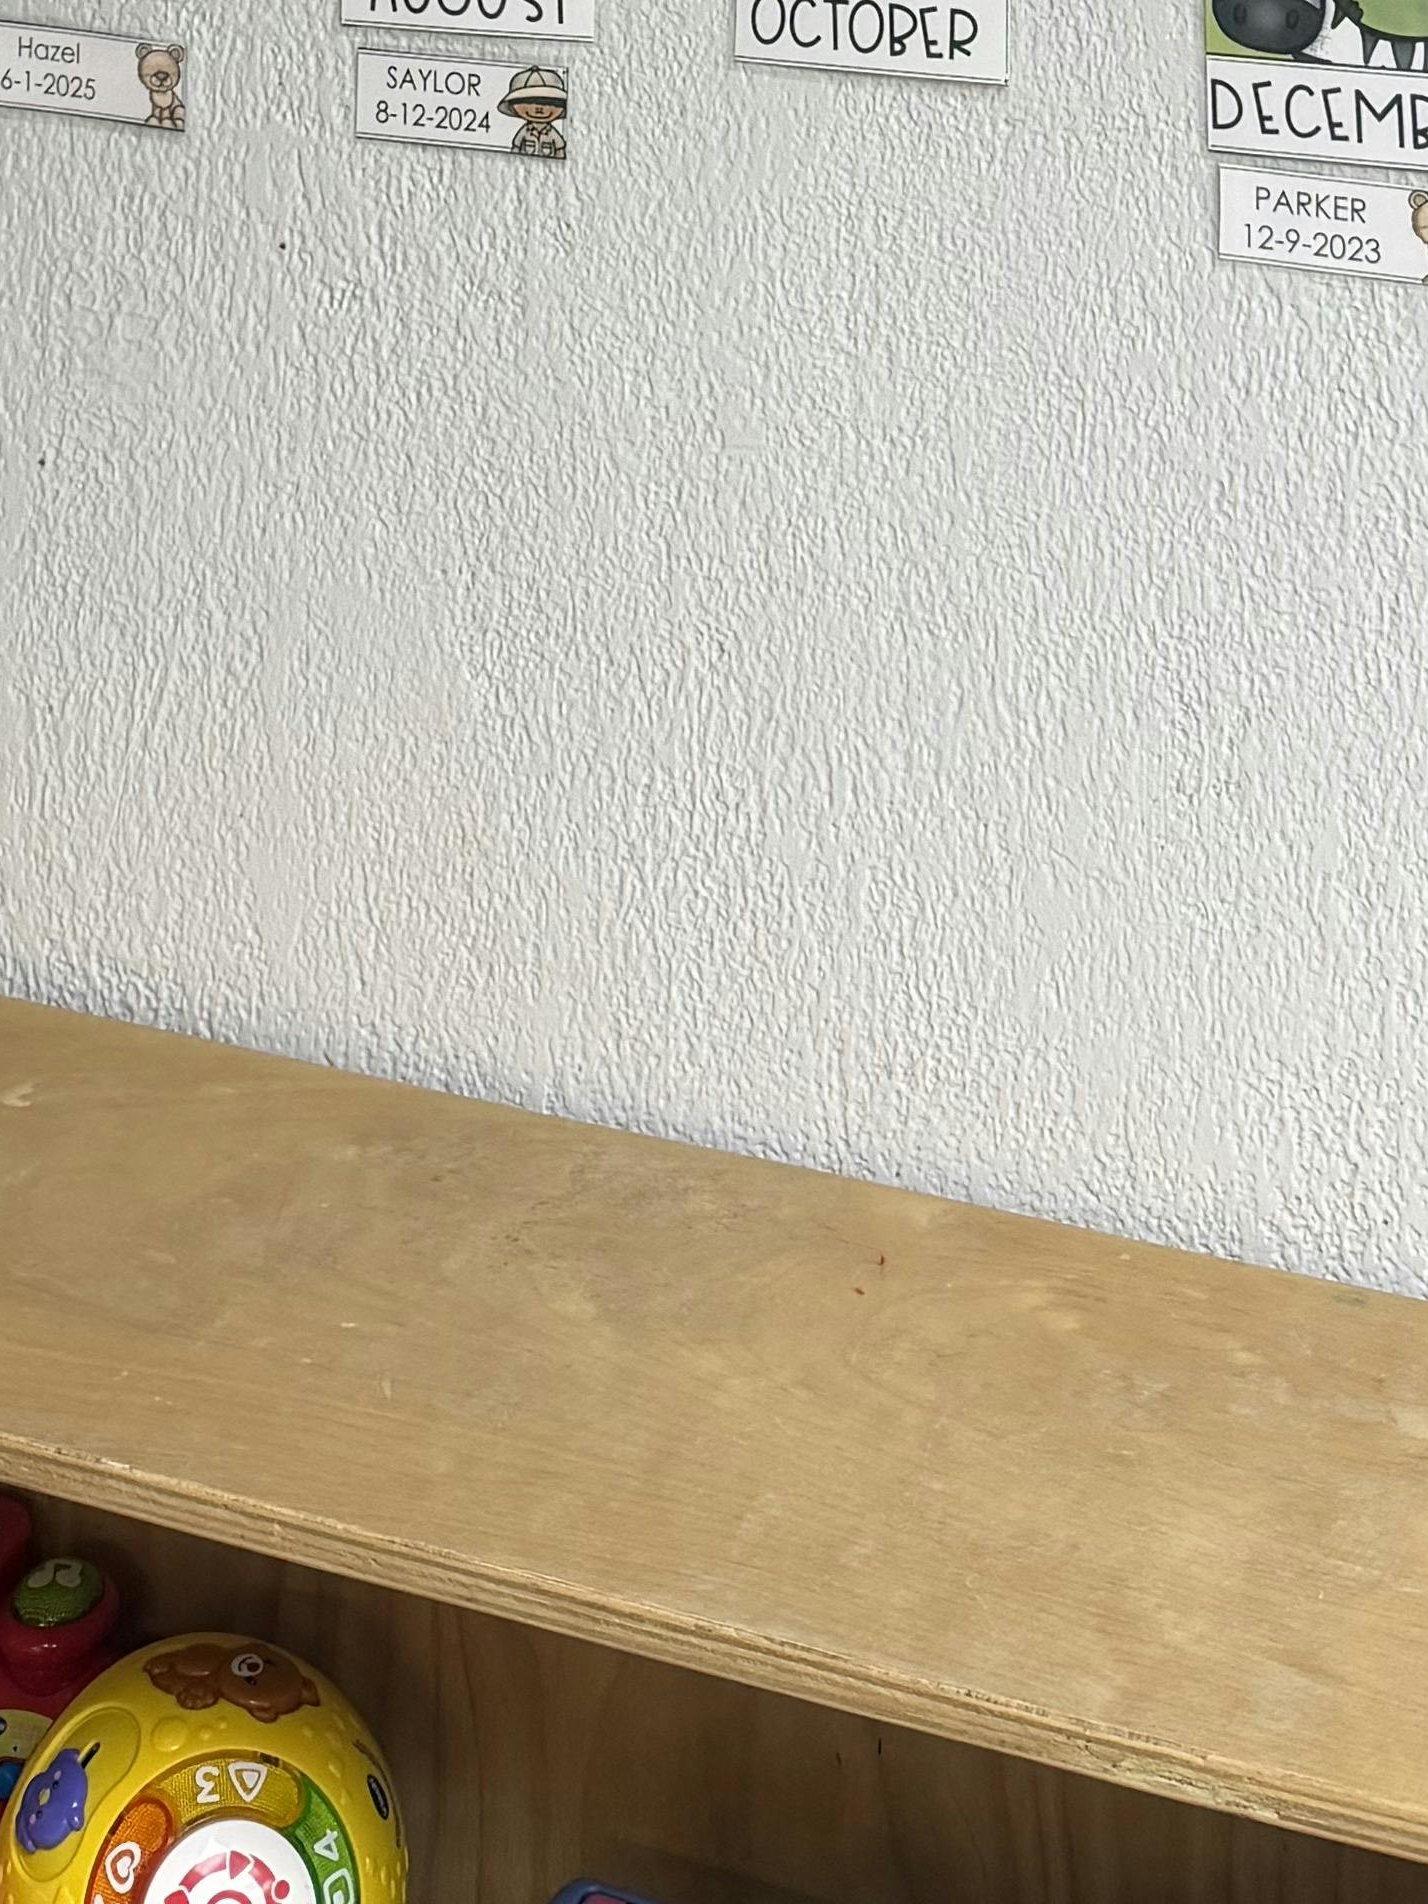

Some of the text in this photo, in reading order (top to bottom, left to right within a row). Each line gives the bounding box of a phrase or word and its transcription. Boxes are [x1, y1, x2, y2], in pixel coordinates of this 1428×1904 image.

[19, 37, 80, 64] Hazel
[387, 66, 480, 96] SAYLOR
[373, 101, 490, 135] 8-12-2024
[1256, 184, 1368, 223] PARKER
[1242, 224, 1381, 265] 12-9-2023
[195, 1765, 220, 1804] 3
